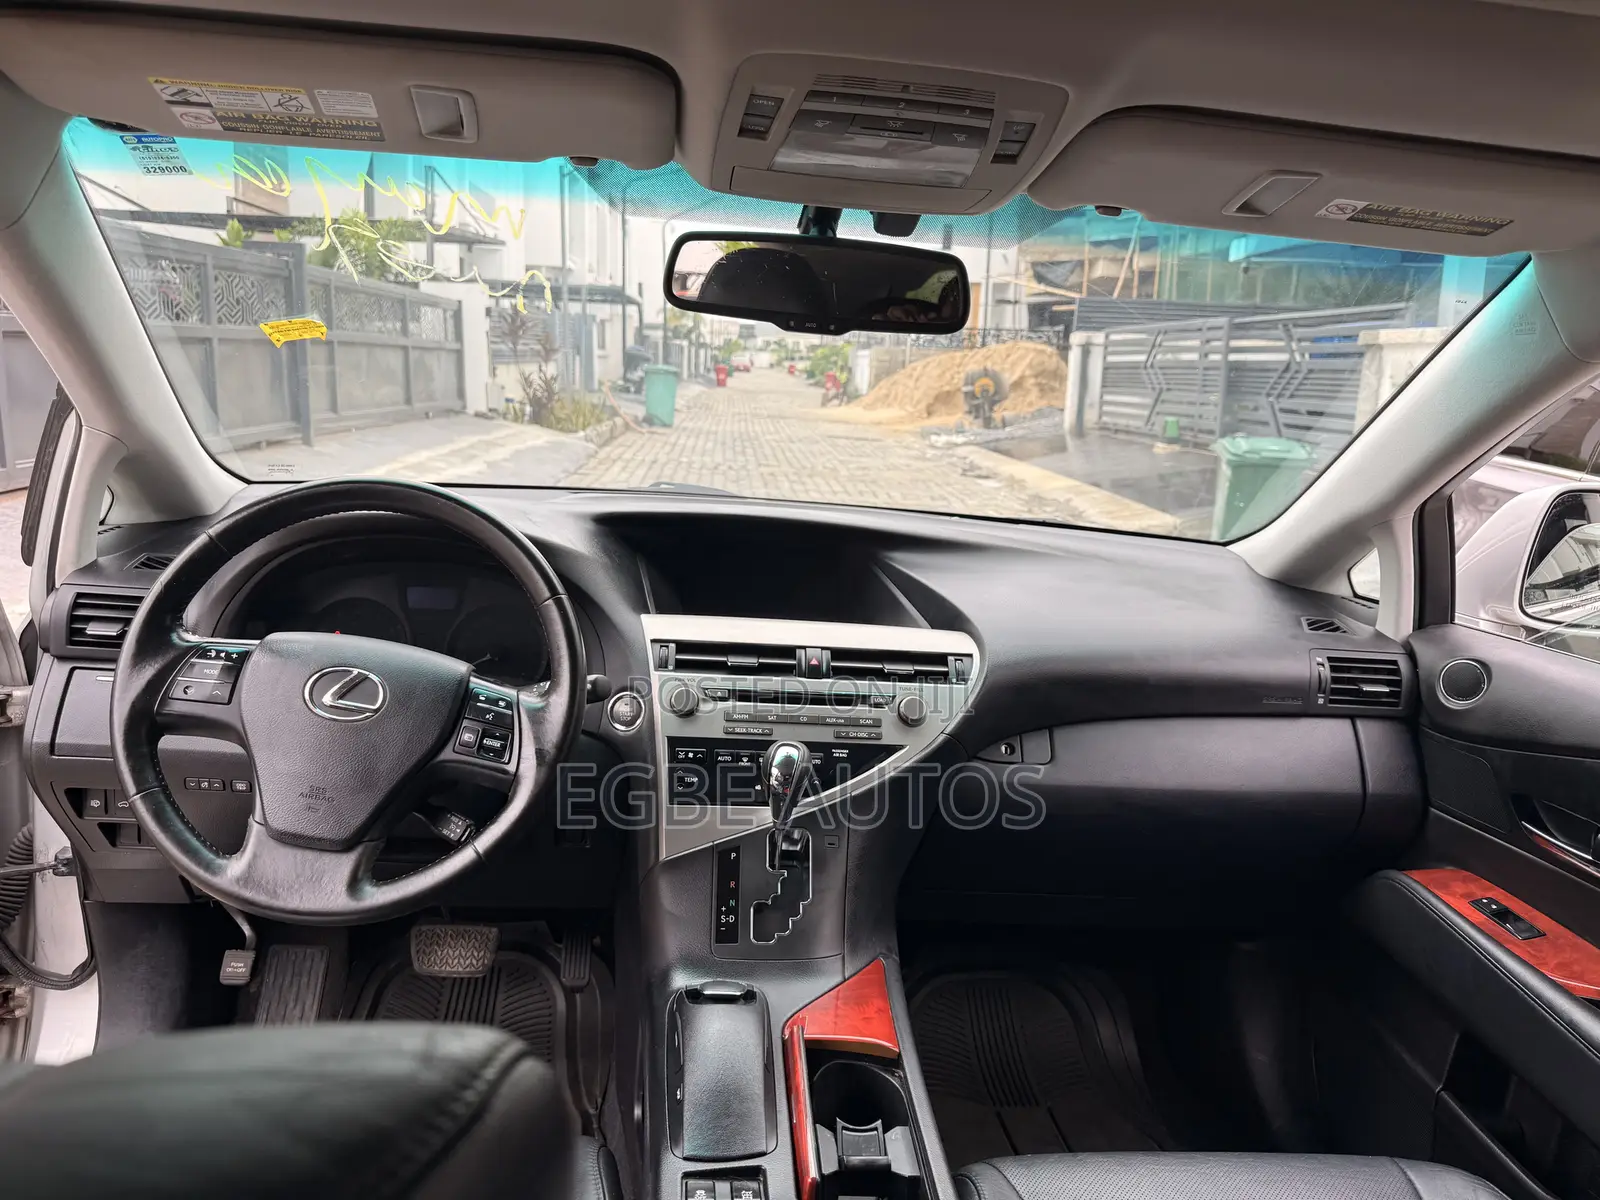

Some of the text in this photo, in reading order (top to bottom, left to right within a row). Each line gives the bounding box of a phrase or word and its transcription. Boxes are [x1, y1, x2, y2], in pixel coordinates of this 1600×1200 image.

[216, 110, 378, 127] AIR BAG WARNING
[221, 121, 381, 137] COUSSIN GONFLABLE AVERTISSEMENT
[143, 165, 188, 174] 329000
[1435, 211, 1510, 225] WARNING
[297, 791, 336, 804] AIRBAG
[730, 852, 737, 860] P
[729, 899, 736, 907] N
